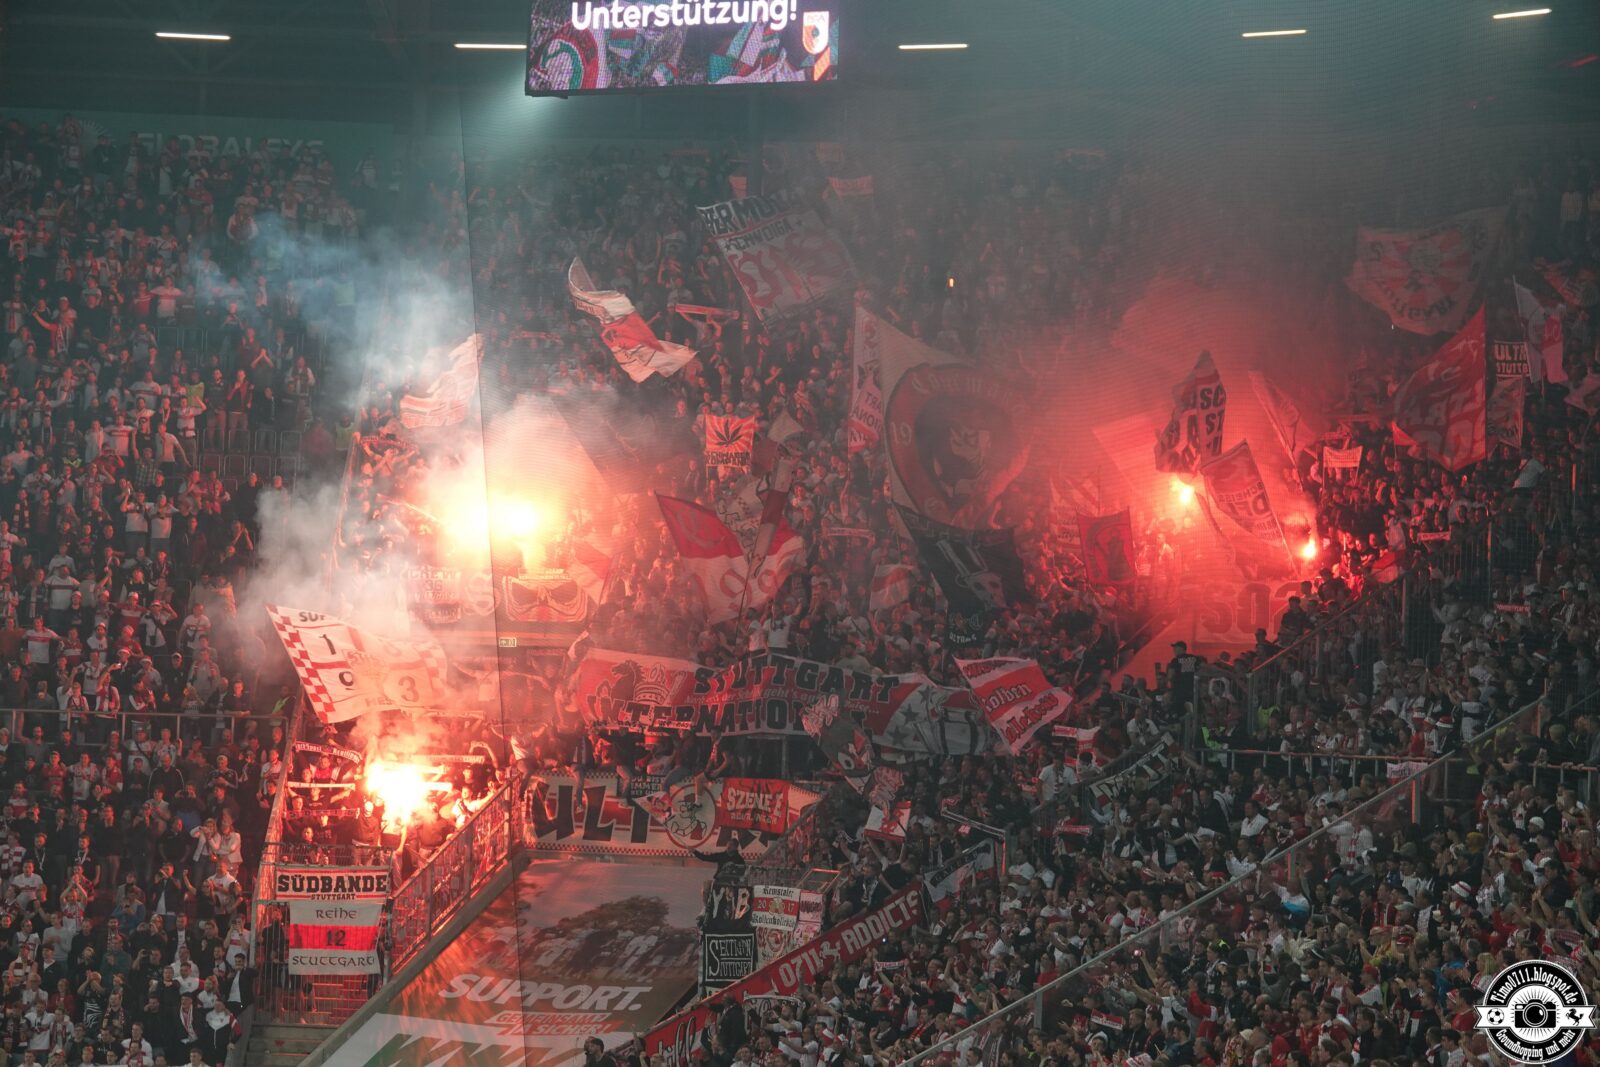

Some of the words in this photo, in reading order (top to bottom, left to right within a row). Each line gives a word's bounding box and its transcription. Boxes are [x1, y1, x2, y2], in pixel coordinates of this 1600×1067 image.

[571, 0, 797, 31] Unterstützung!
[398, 675, 420, 702] 3
[277, 873, 387, 893] SÜDBANDE
[326, 929, 347, 947] 12
[778, 945, 823, 988] 0711
[439, 973, 653, 1011] SUPPORT.
